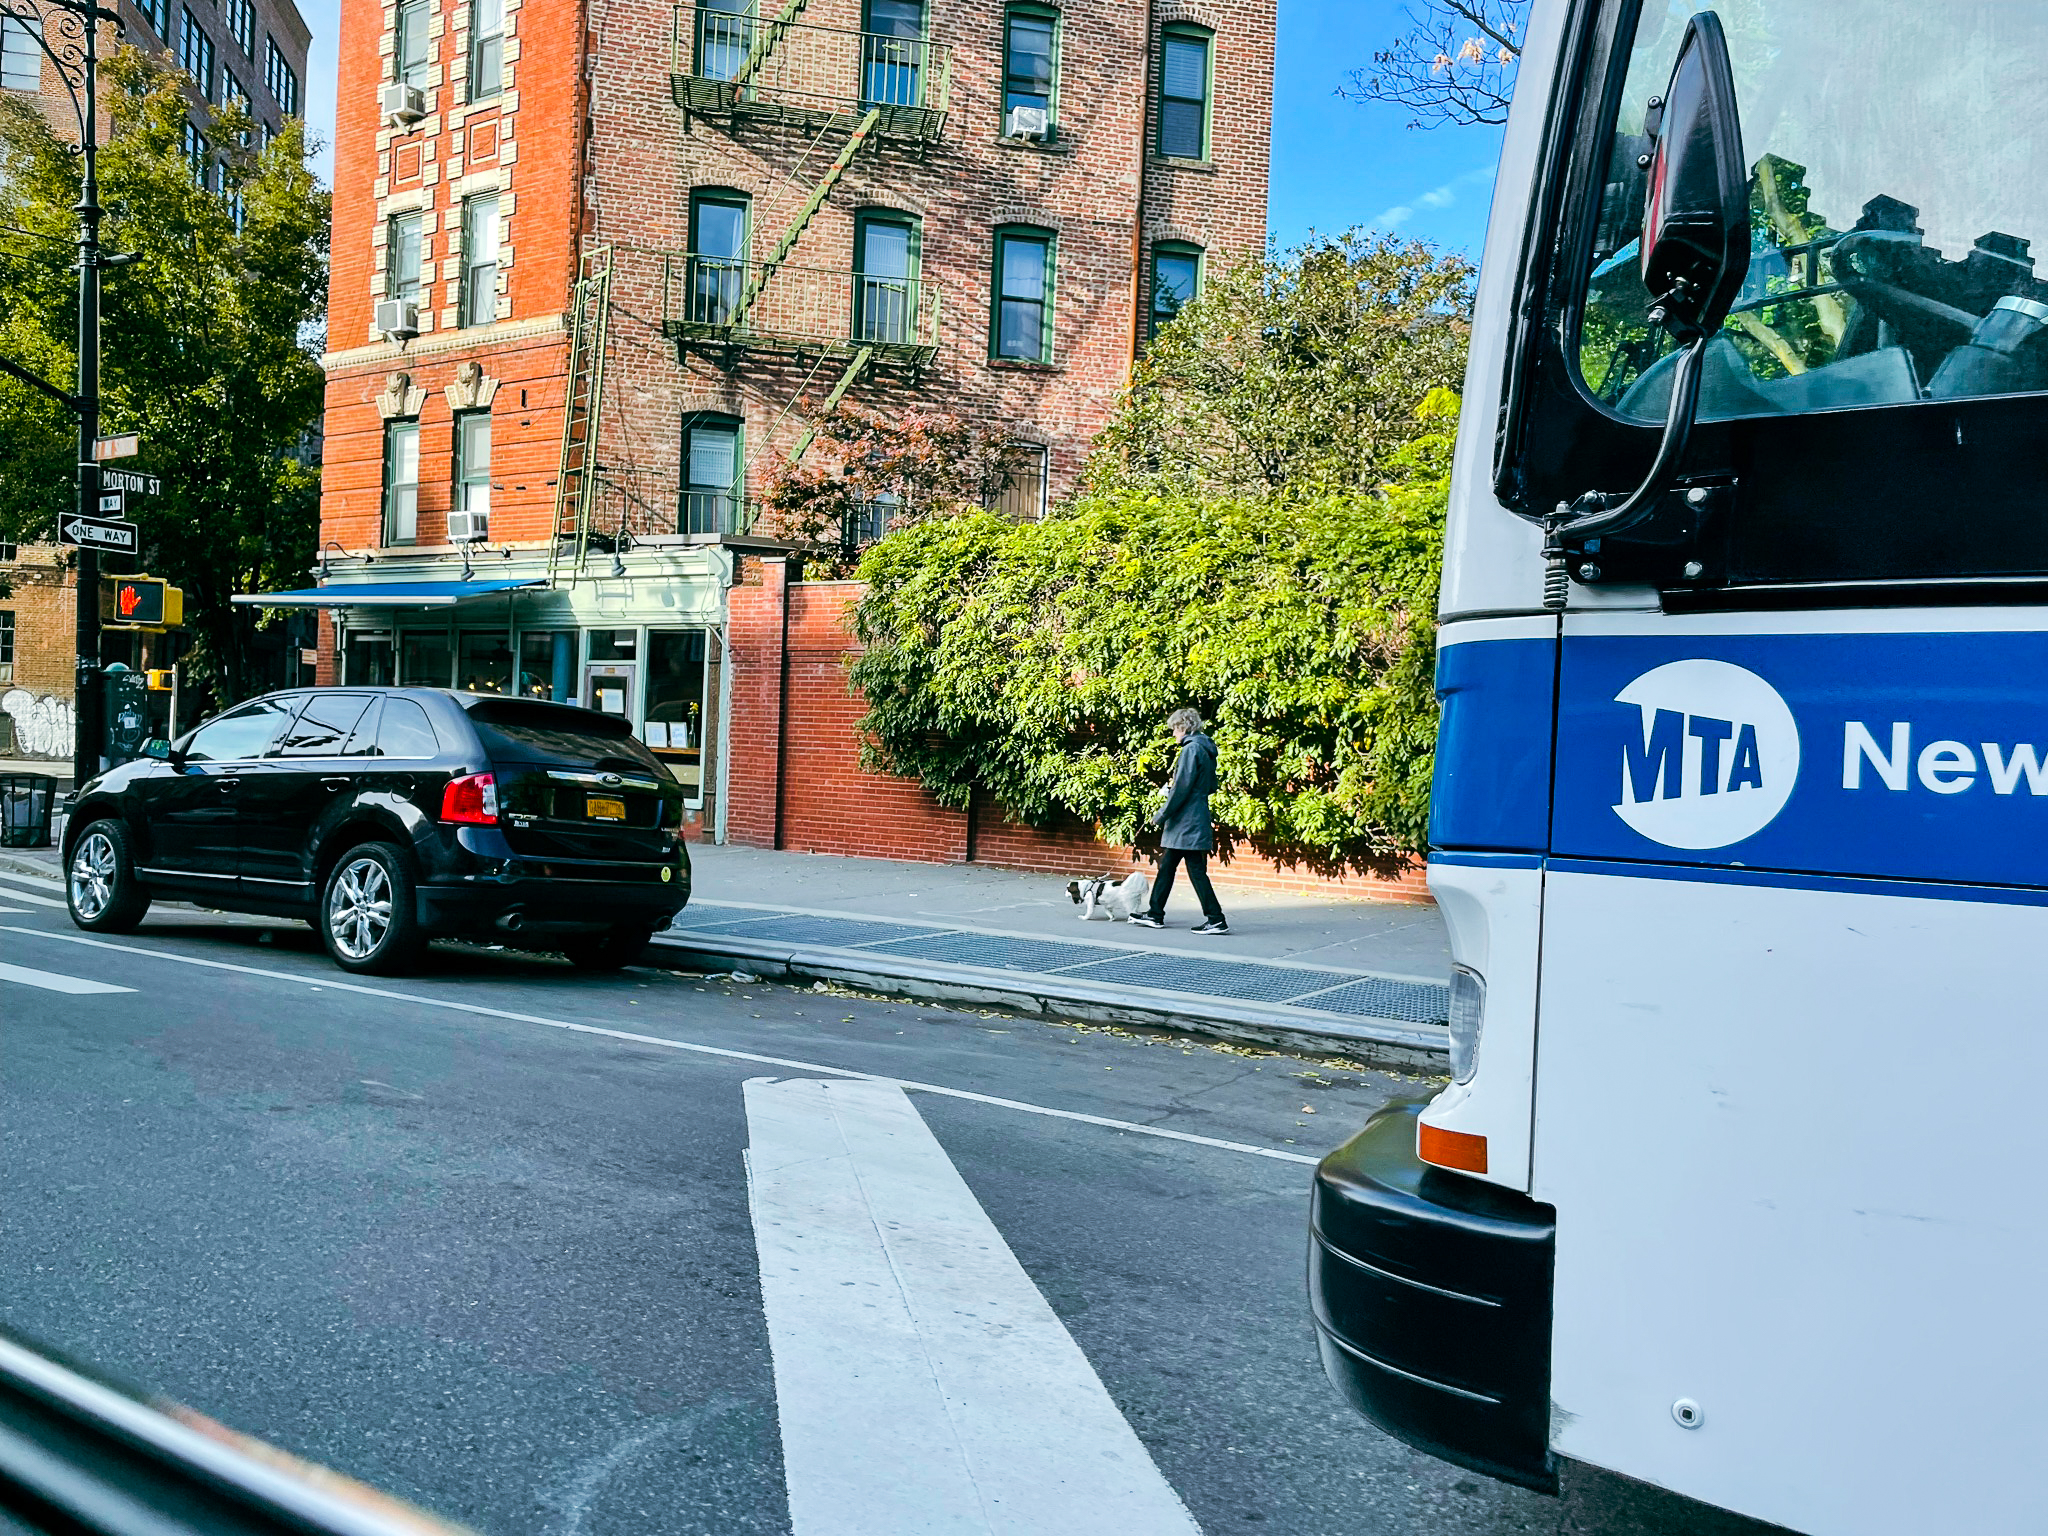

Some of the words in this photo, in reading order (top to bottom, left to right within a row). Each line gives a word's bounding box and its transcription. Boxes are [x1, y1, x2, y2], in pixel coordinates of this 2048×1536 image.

[103, 471, 143, 493] MORTON
[149, 479, 160, 496] ST
[104, 498, 118, 509] WAY
[72, 525, 94, 538] ONE
[104, 530, 127, 543] WAY
[1612, 701, 1763, 806] MTA
[1842, 720, 2048, 796] New
